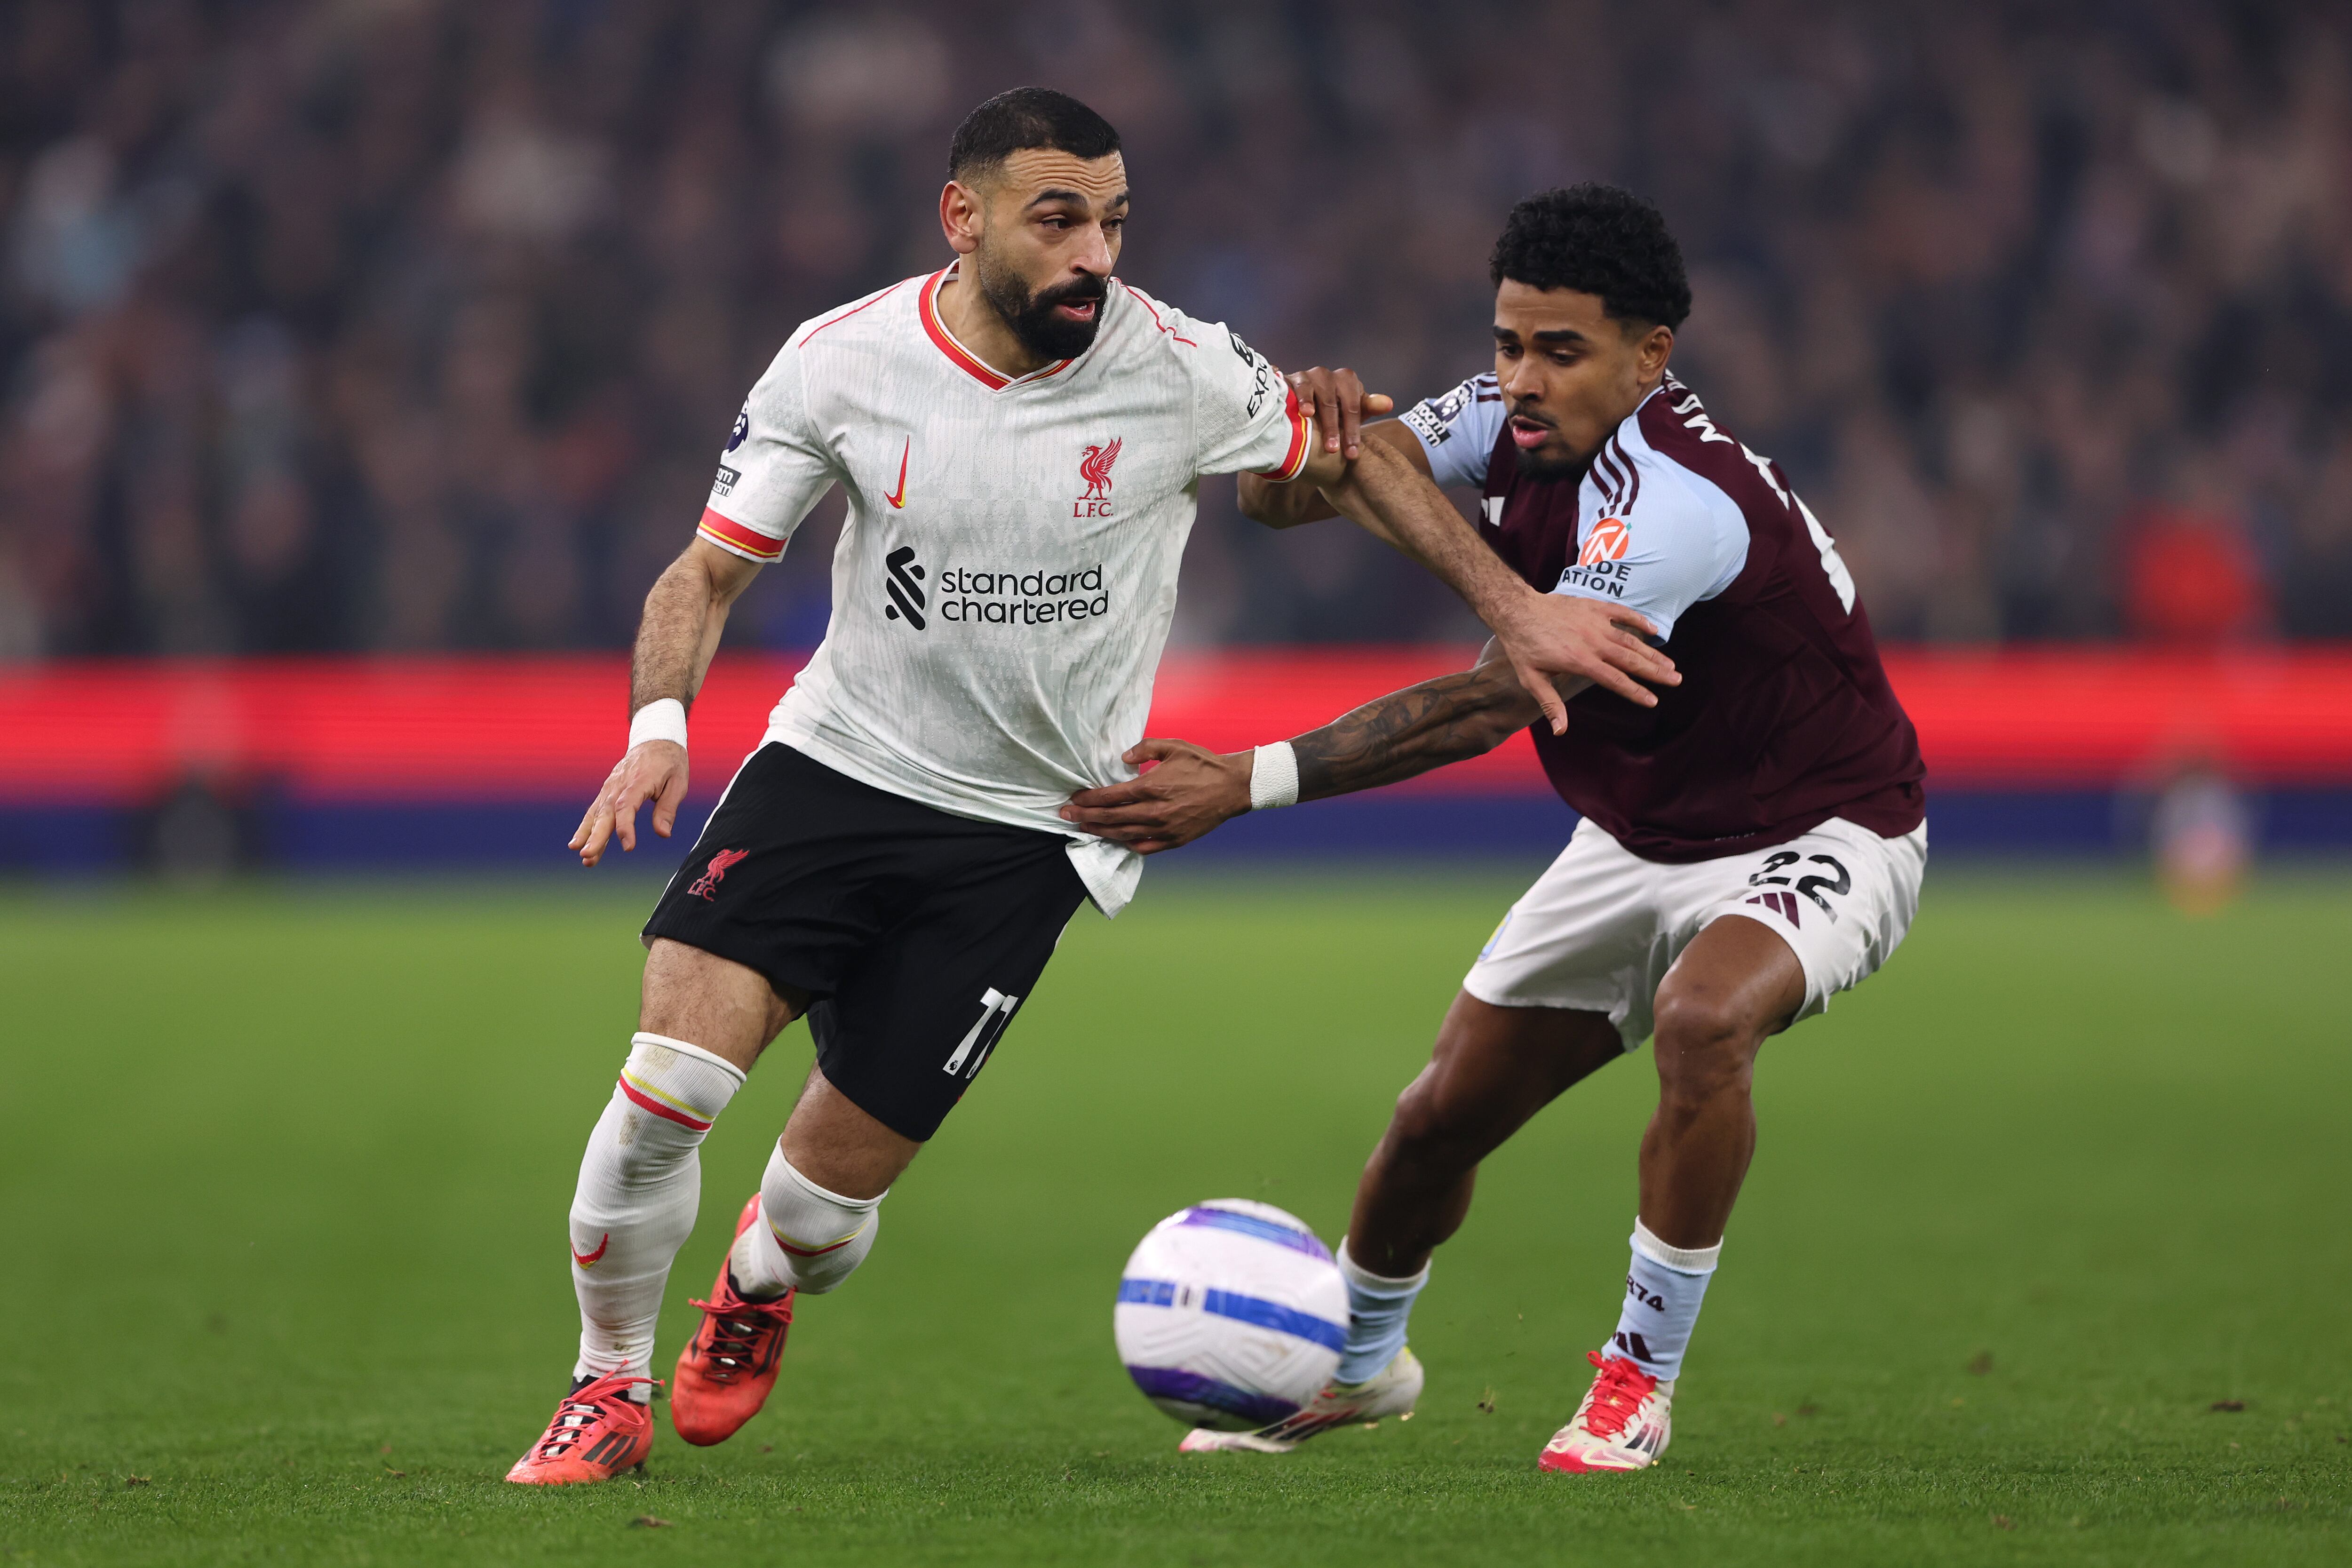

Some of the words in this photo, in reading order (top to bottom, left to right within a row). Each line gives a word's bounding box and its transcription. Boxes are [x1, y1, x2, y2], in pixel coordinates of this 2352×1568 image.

[1073, 502, 1113, 517] L.F.C.
[941, 564, 1102, 596] standard
[1562, 569, 1624, 598] ATION
[941, 590, 1109, 625] chartered
[1748, 851, 1851, 925] 22
[942, 987, 1019, 1079] 11
